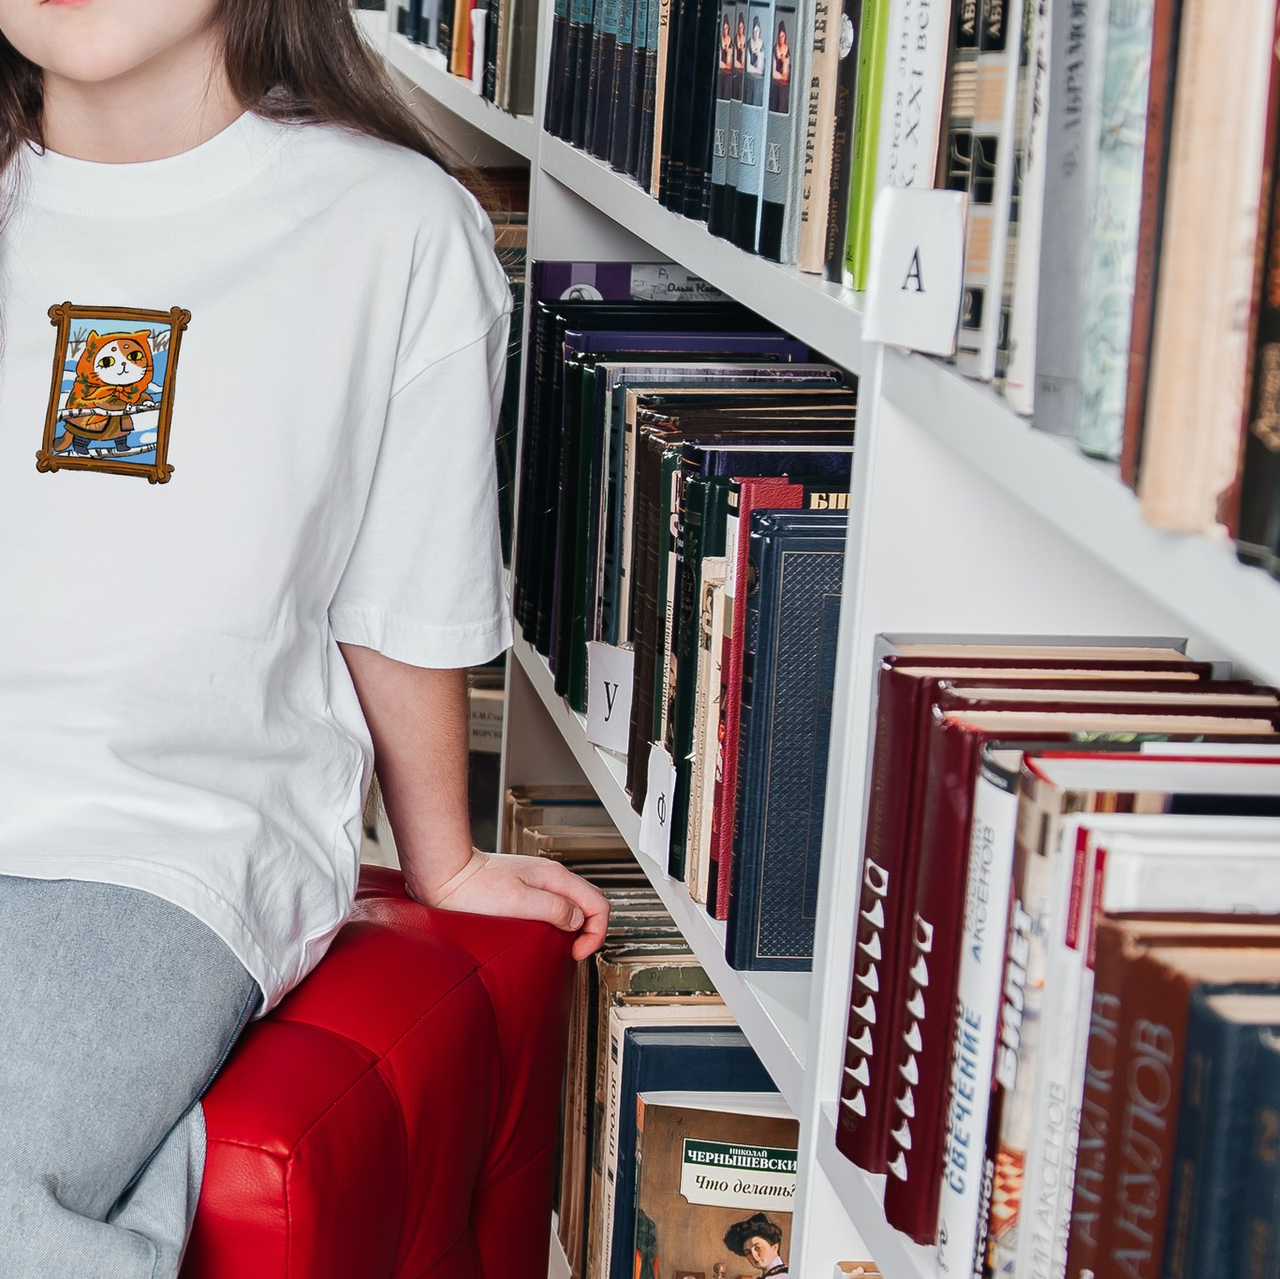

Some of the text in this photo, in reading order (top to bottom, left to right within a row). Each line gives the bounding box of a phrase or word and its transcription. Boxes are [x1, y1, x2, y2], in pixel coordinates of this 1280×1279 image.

[803, 75, 821, 177] ТУРГЕНЕВ
[904, 69, 923, 143] XXI
[833, 130, 847, 192] Первая
[828, 198, 842, 260] любовь
[901, 246, 926, 293] А
[657, 791, 667, 827] Ф
[969, 824, 996, 964] АКСЕНОВ
[993, 897, 1034, 1091] БИЛЕТ
[607, 1071, 619, 1156] ПРОЛОГ
[948, 1005, 982, 1196] СВЕЧЕНИЕ
[1072, 991, 1120, 1246] АКУЛОВ
[687, 1149, 798, 1172] ЧЕРНЫШЕВСКИ
[695, 1174, 797, 1198] Что делать?
[729, 1147, 768, 1158] НИКОЛАЙ
[1035, 1080, 1065, 1227] АКСЕНОВ
